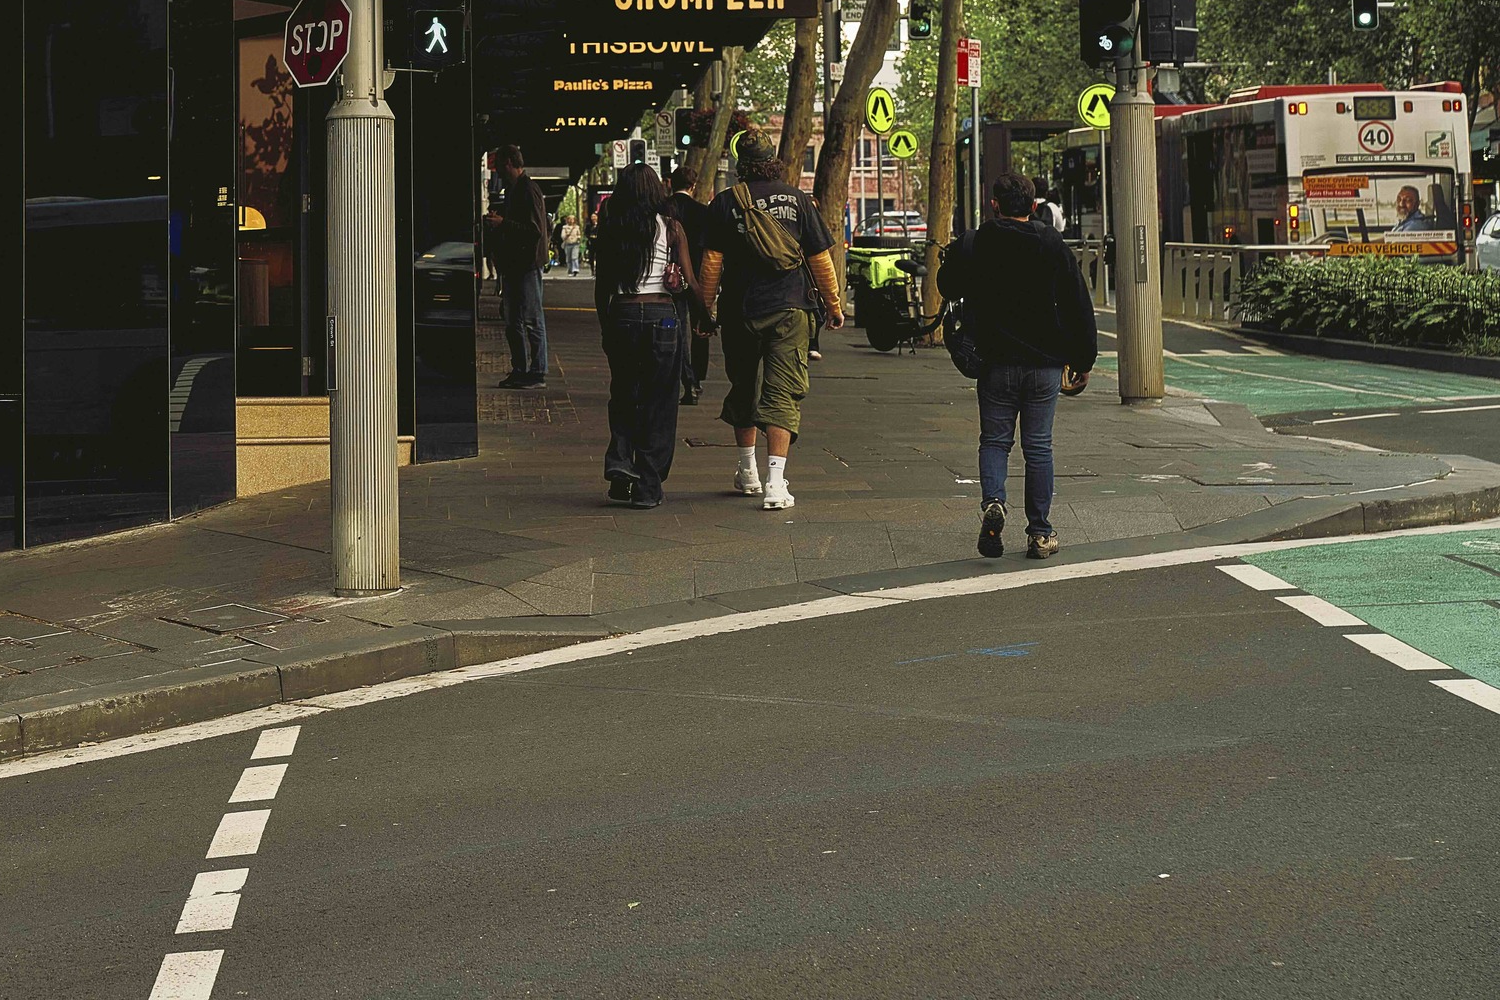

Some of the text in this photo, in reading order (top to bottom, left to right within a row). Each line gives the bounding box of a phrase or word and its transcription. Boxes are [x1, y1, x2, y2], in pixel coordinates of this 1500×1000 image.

[291, 18, 343, 56] STOP
[553, 78, 653, 91] Paulie's Pizza
[1358, 101, 1390, 117] 333
[1362, 129, 1390, 146] 40
[769, 194, 798, 207] FOR
[1340, 244, 1423, 254] LONG VEHICLE
